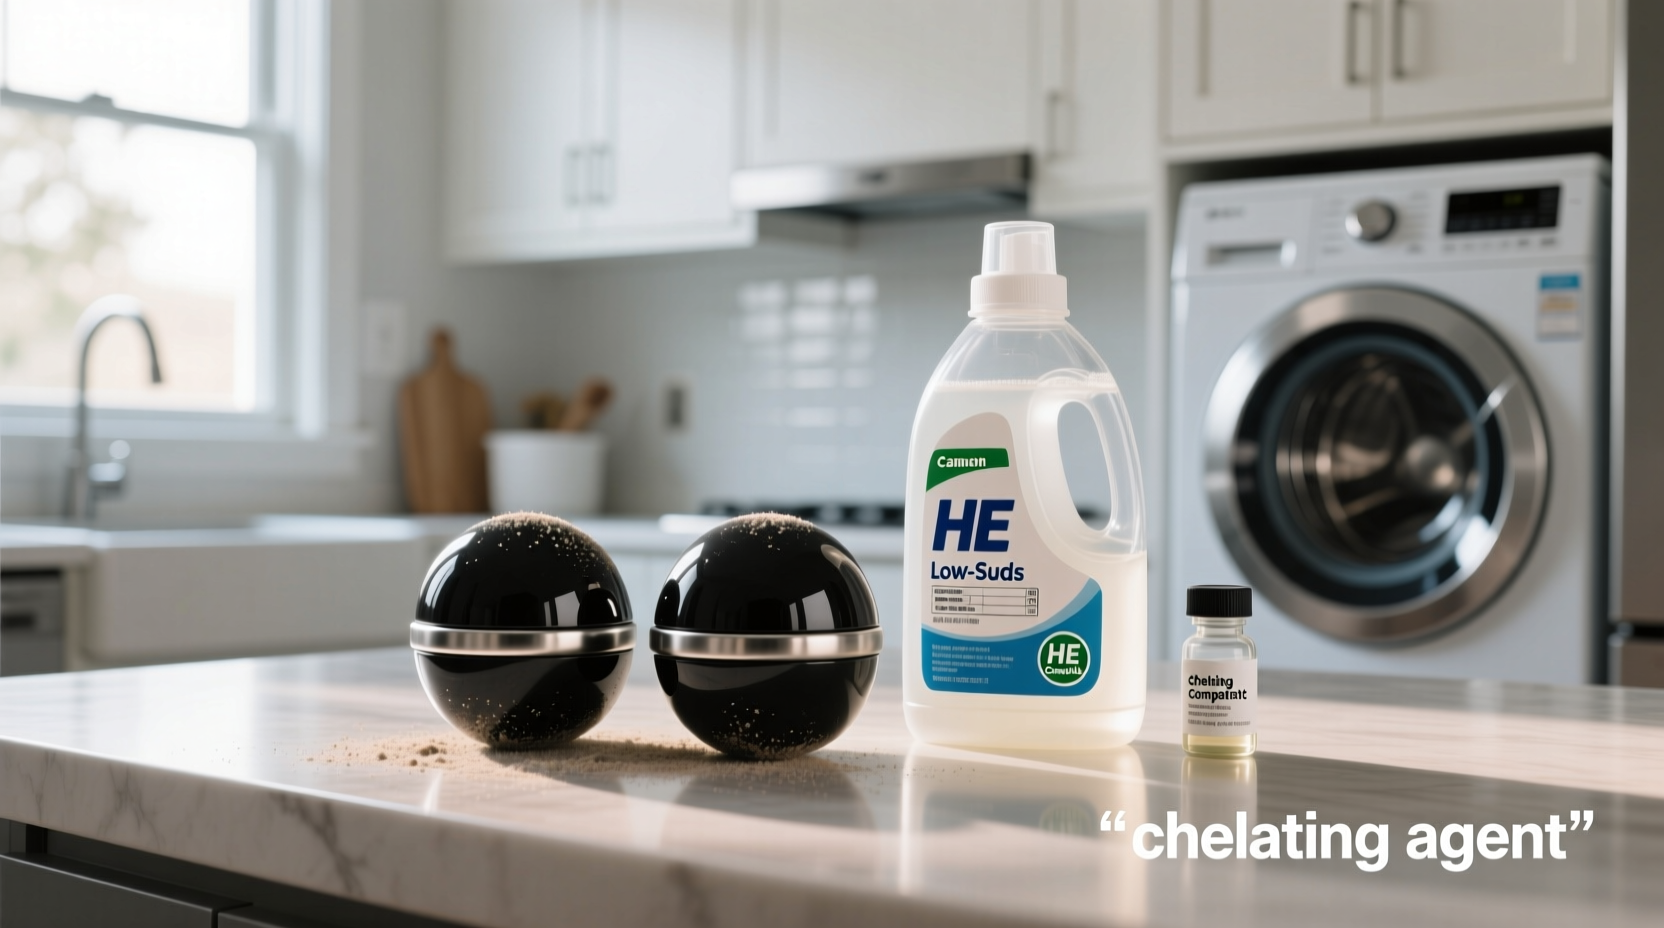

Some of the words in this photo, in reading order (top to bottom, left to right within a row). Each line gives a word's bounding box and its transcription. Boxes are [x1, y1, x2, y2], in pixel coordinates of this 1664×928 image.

[932, 499, 1015, 552] HE
[931, 561, 1025, 581] Low-Suds
[1047, 643, 1081, 665] HE
